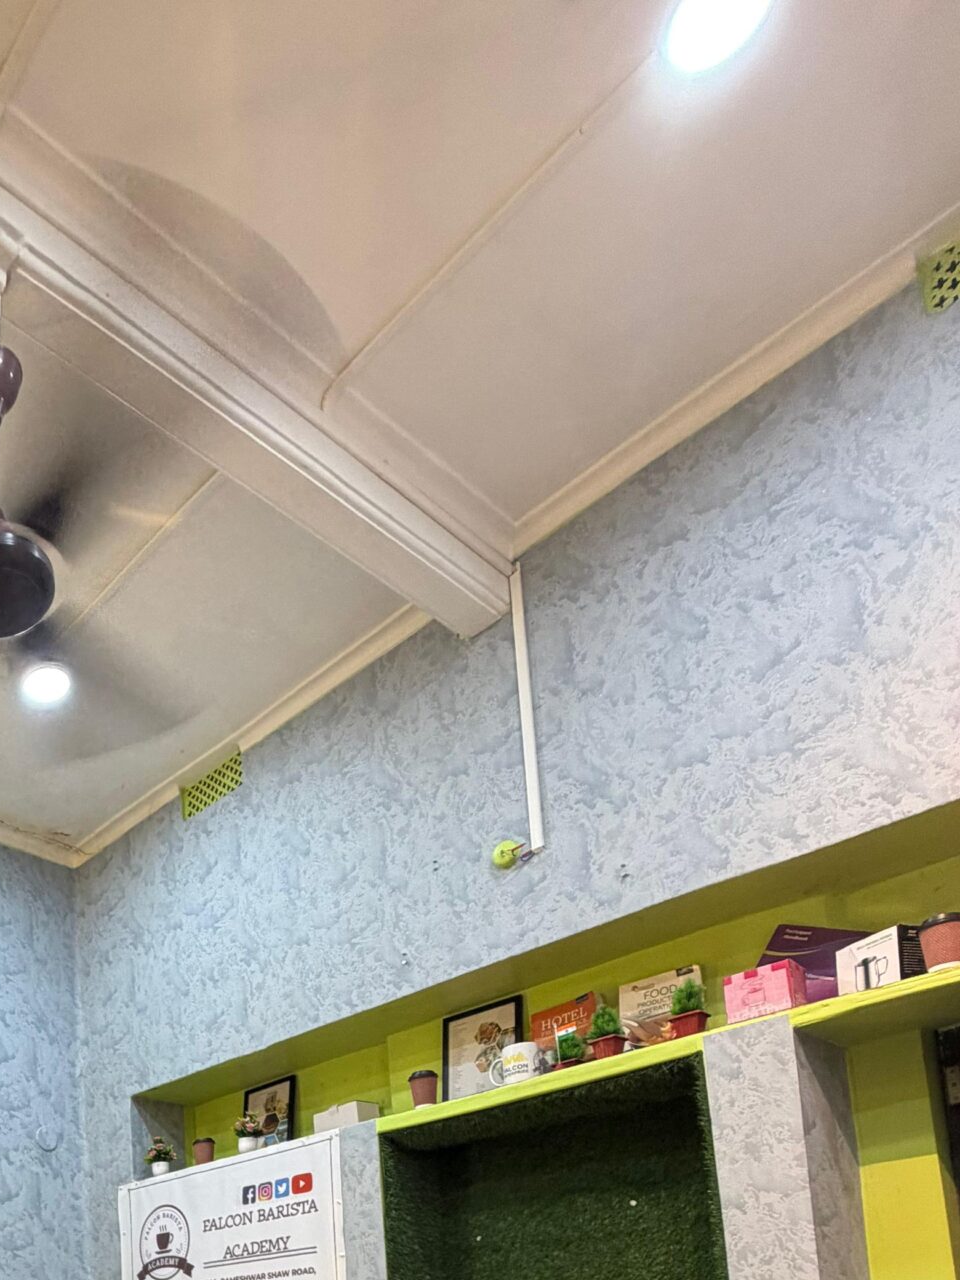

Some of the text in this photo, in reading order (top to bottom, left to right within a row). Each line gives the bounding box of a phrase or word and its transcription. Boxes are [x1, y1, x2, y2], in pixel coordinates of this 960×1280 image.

[643, 984, 678, 1000] FOOD
[637, 995, 673, 1009] PRODUCT
[541, 1007, 588, 1031] HOTEL
[504, 1063, 529, 1073] ALCON
[202, 1199, 319, 1232] FALCON BARISTA
[223, 1236, 291, 1259] ACADEMY
[147, 1258, 180, 1272] ACADEMY
[267, 1270, 290, 1280] SHAW
[291, 1266, 317, 1276] ROAD,
